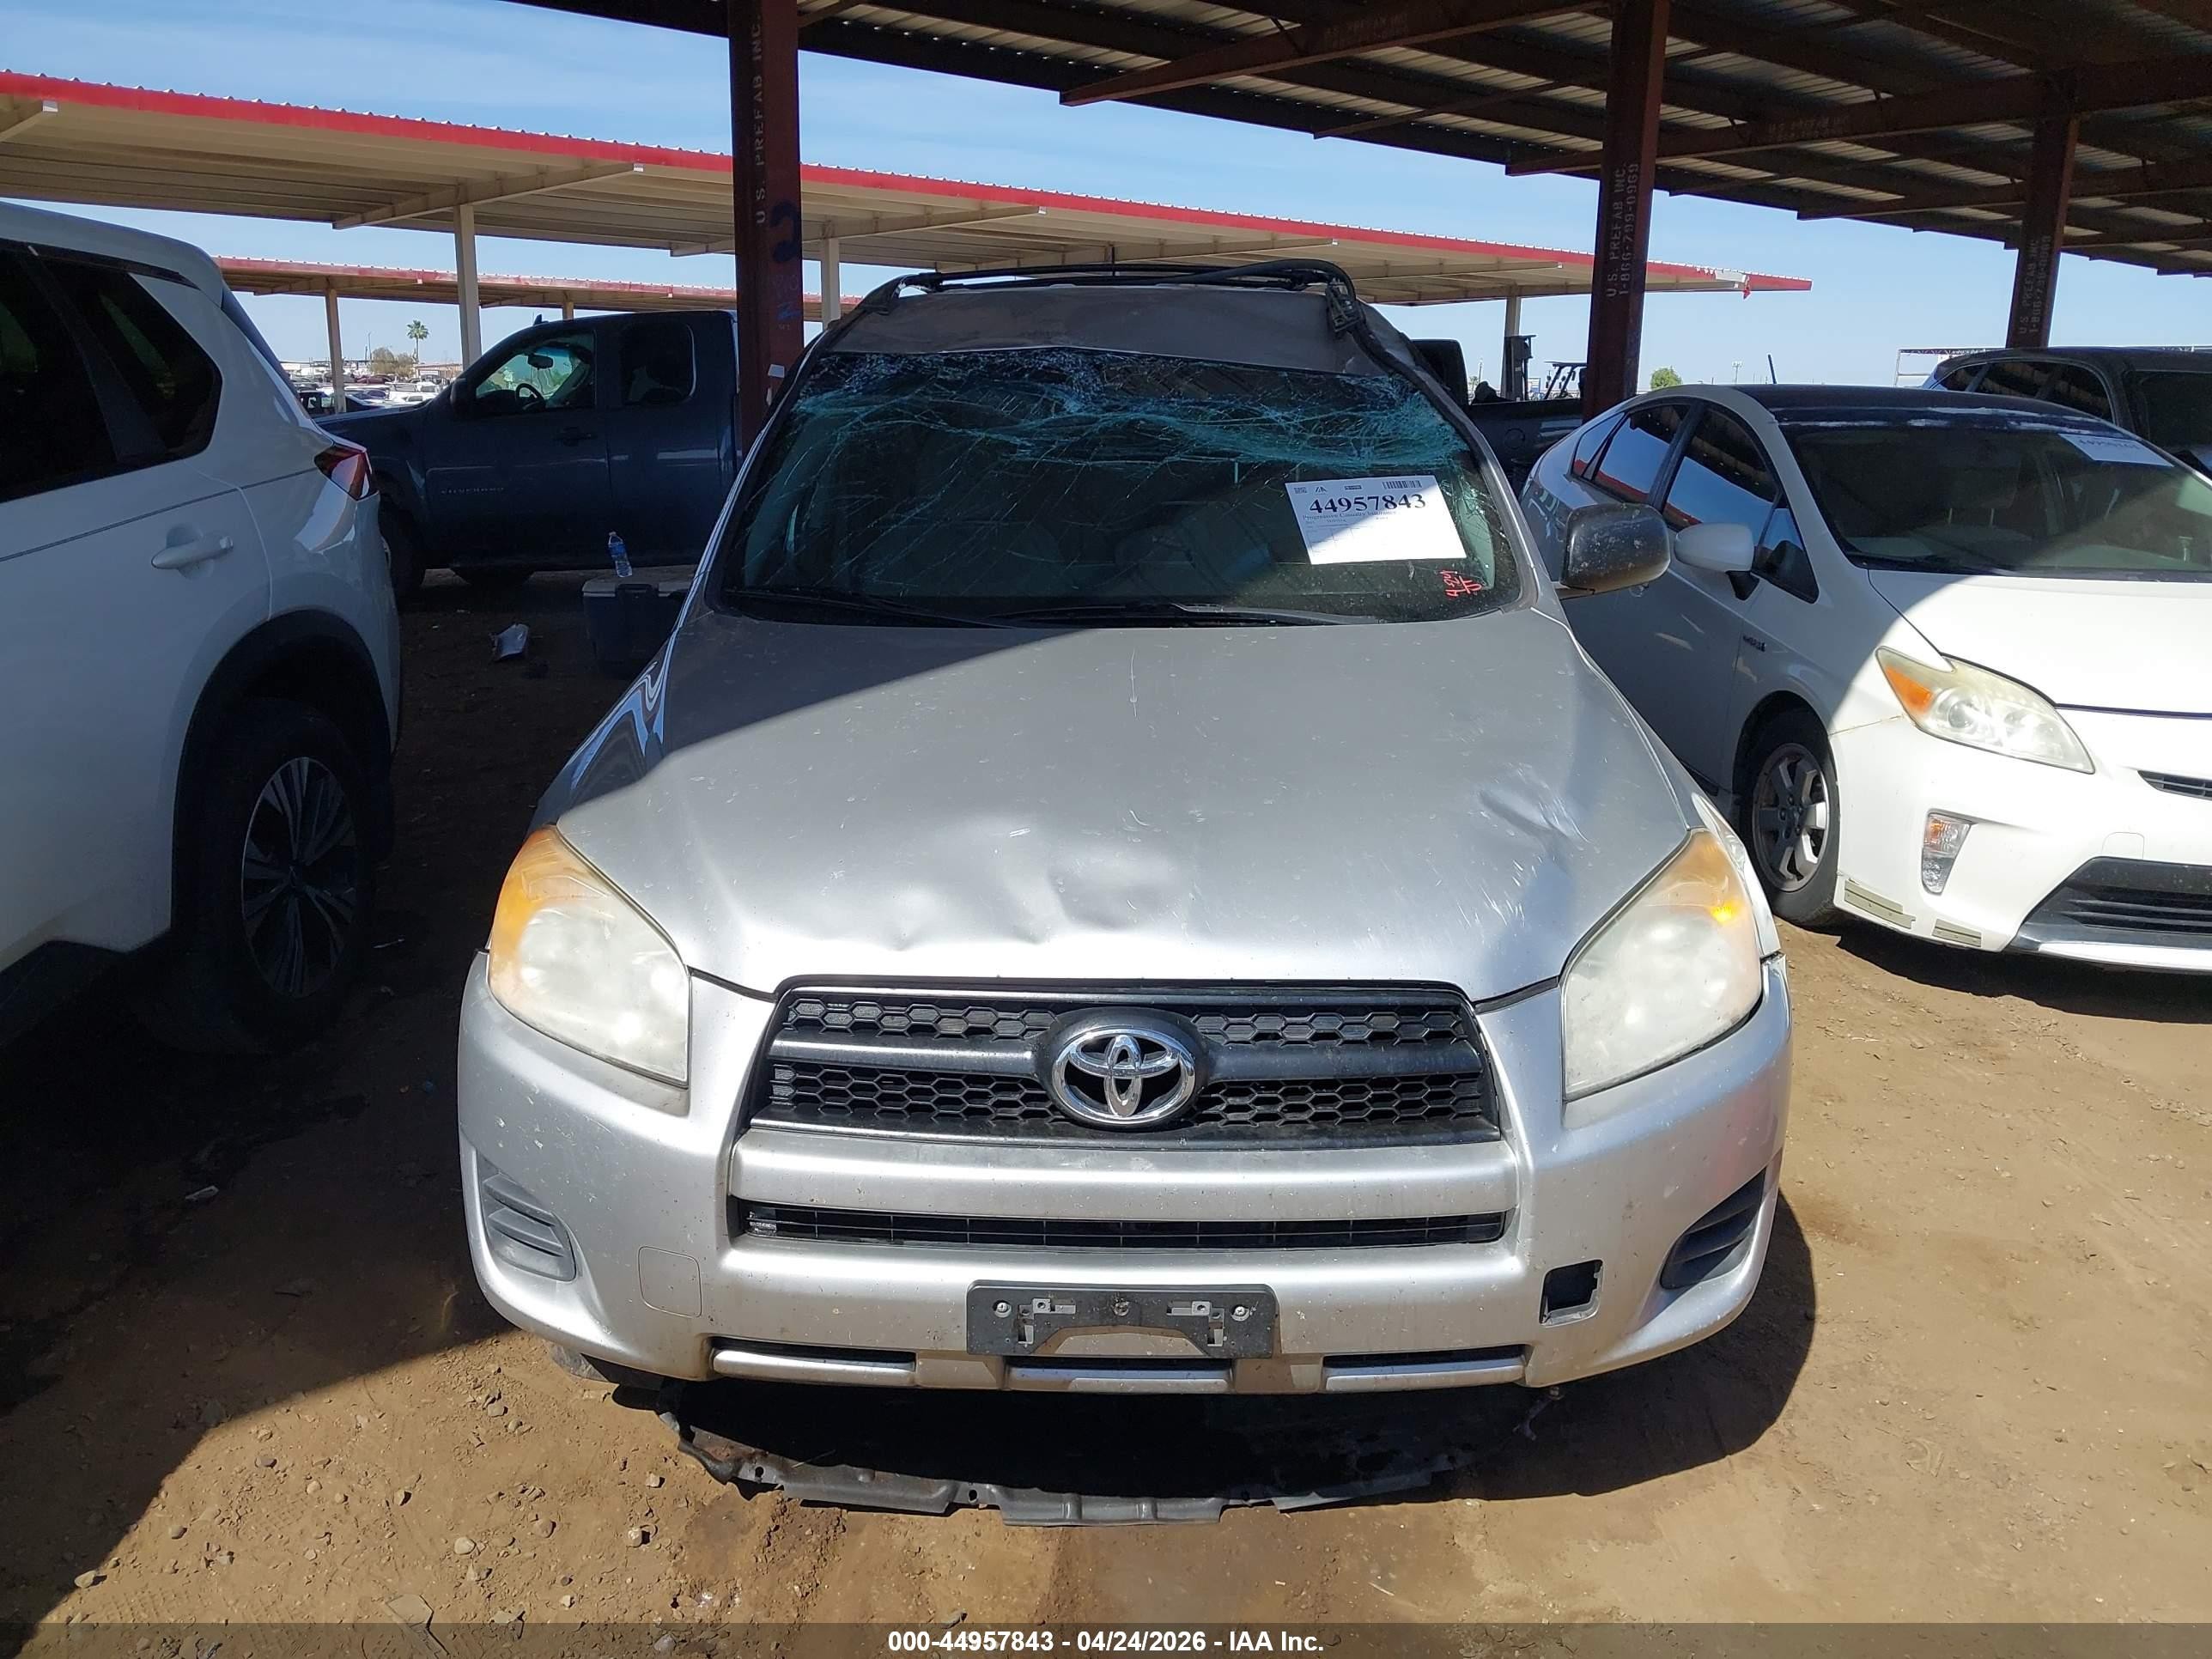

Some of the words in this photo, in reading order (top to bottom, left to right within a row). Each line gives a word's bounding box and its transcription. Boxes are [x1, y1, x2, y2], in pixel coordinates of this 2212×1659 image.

[750, 14, 762, 61] INC.
[752, 76, 764, 167] PREFAB
[1609, 201, 1624, 261] PREFAB
[1310, 493, 1426, 514] 44957843
